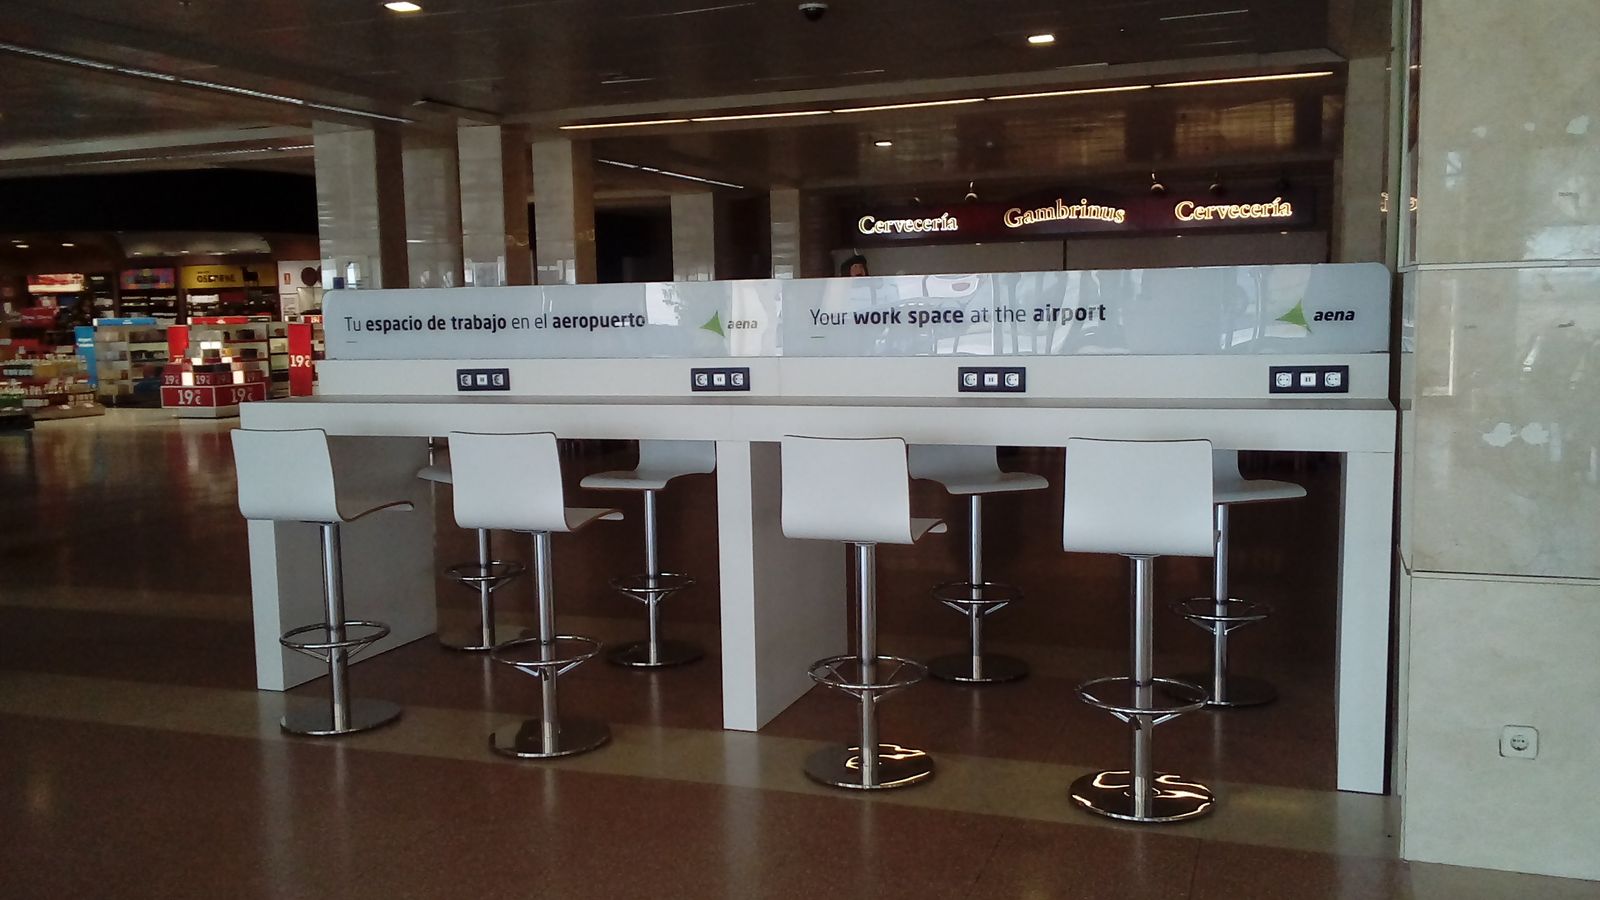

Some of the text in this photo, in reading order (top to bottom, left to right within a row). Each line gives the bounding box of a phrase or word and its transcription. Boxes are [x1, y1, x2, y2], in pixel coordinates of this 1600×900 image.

[1004, 198, 1125, 228] Gambrinus
[1174, 197, 1292, 221] Cervecería
[858, 212, 958, 234] Cervecería
[344, 312, 645, 334] Tu espacio de trabajo en el aeropuerto
[727, 320, 758, 330] aena
[810, 304, 1107, 328] Your work space at the airport
[1313, 310, 1355, 322] aena
